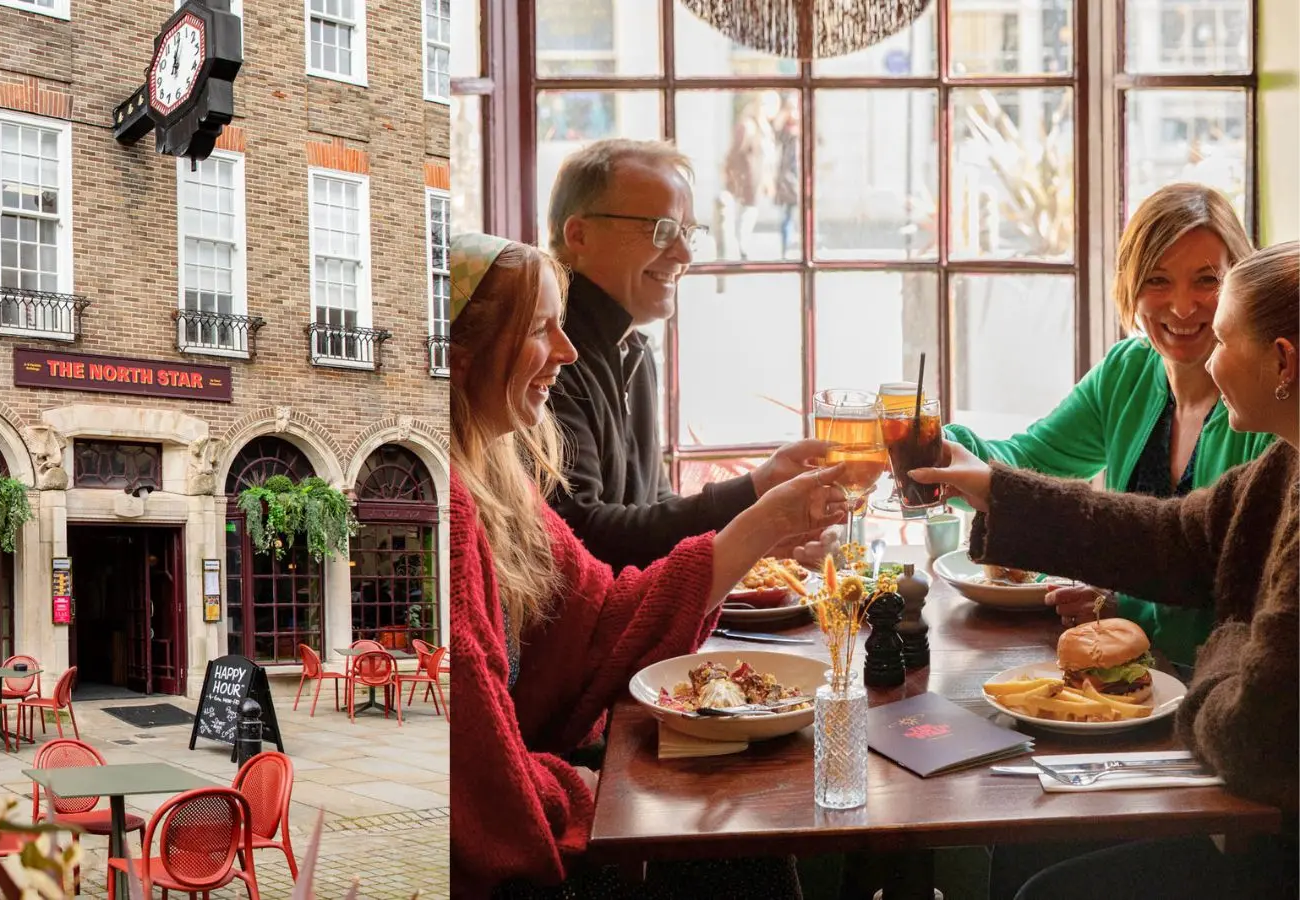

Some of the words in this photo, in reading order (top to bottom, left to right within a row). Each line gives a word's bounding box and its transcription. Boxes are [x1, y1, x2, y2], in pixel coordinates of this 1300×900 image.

[191, 31, 196, 43] 2
[194, 43, 200, 56] 3
[157, 77, 162, 88] 9
[160, 89, 164, 99] 8
[166, 93, 171, 104] 7
[175, 87, 182, 99] 6
[46, 359, 85, 379] THE
[89, 363, 153, 385] NORTH
[157, 369, 204, 389] STAR
[214, 665, 247, 683] HAPPY
